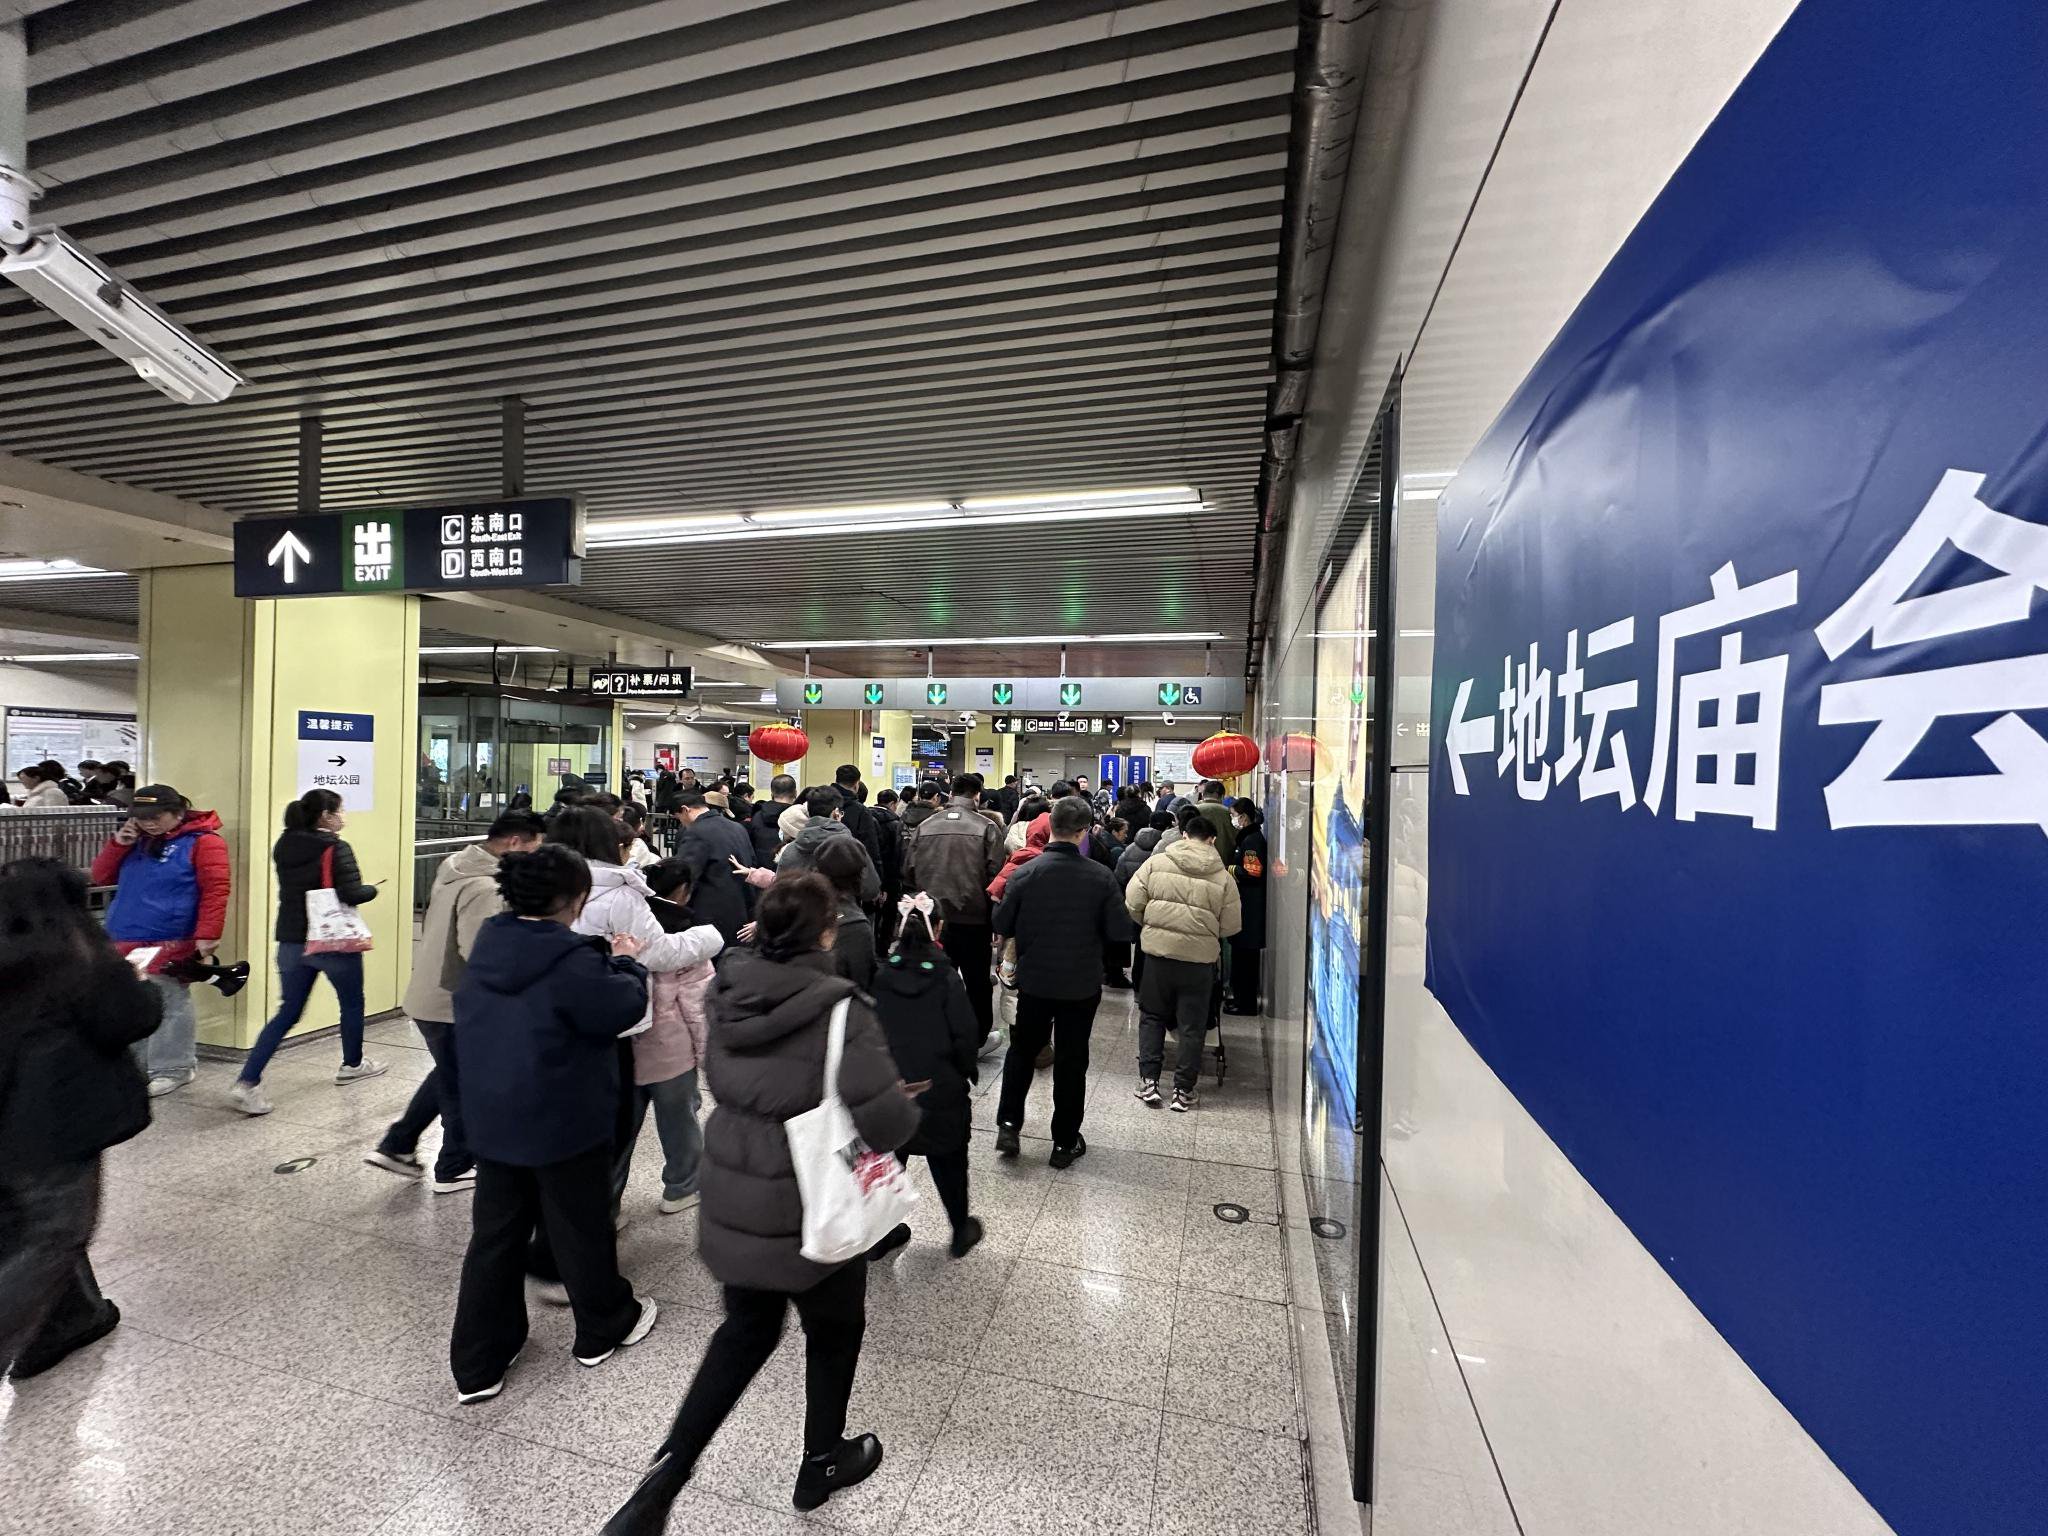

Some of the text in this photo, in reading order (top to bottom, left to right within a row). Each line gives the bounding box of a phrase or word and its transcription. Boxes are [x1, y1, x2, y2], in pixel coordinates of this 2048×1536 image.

[445, 518, 461, 541] C
[470, 512, 523, 534] 东南口
[354, 521, 393, 565] 出
[445, 552, 461, 575] D
[470, 546, 523, 567] 西南口
[354, 565, 393, 582] EXIT
[1497, 468, 2048, 840] 地坛庙会
[629, 673, 684, 687] 补票/问讯
[306, 718, 354, 731] 温馨提示
[1027, 720, 1036, 731] C
[1077, 721, 1086, 731] D
[313, 774, 361, 786] 地坛公园
